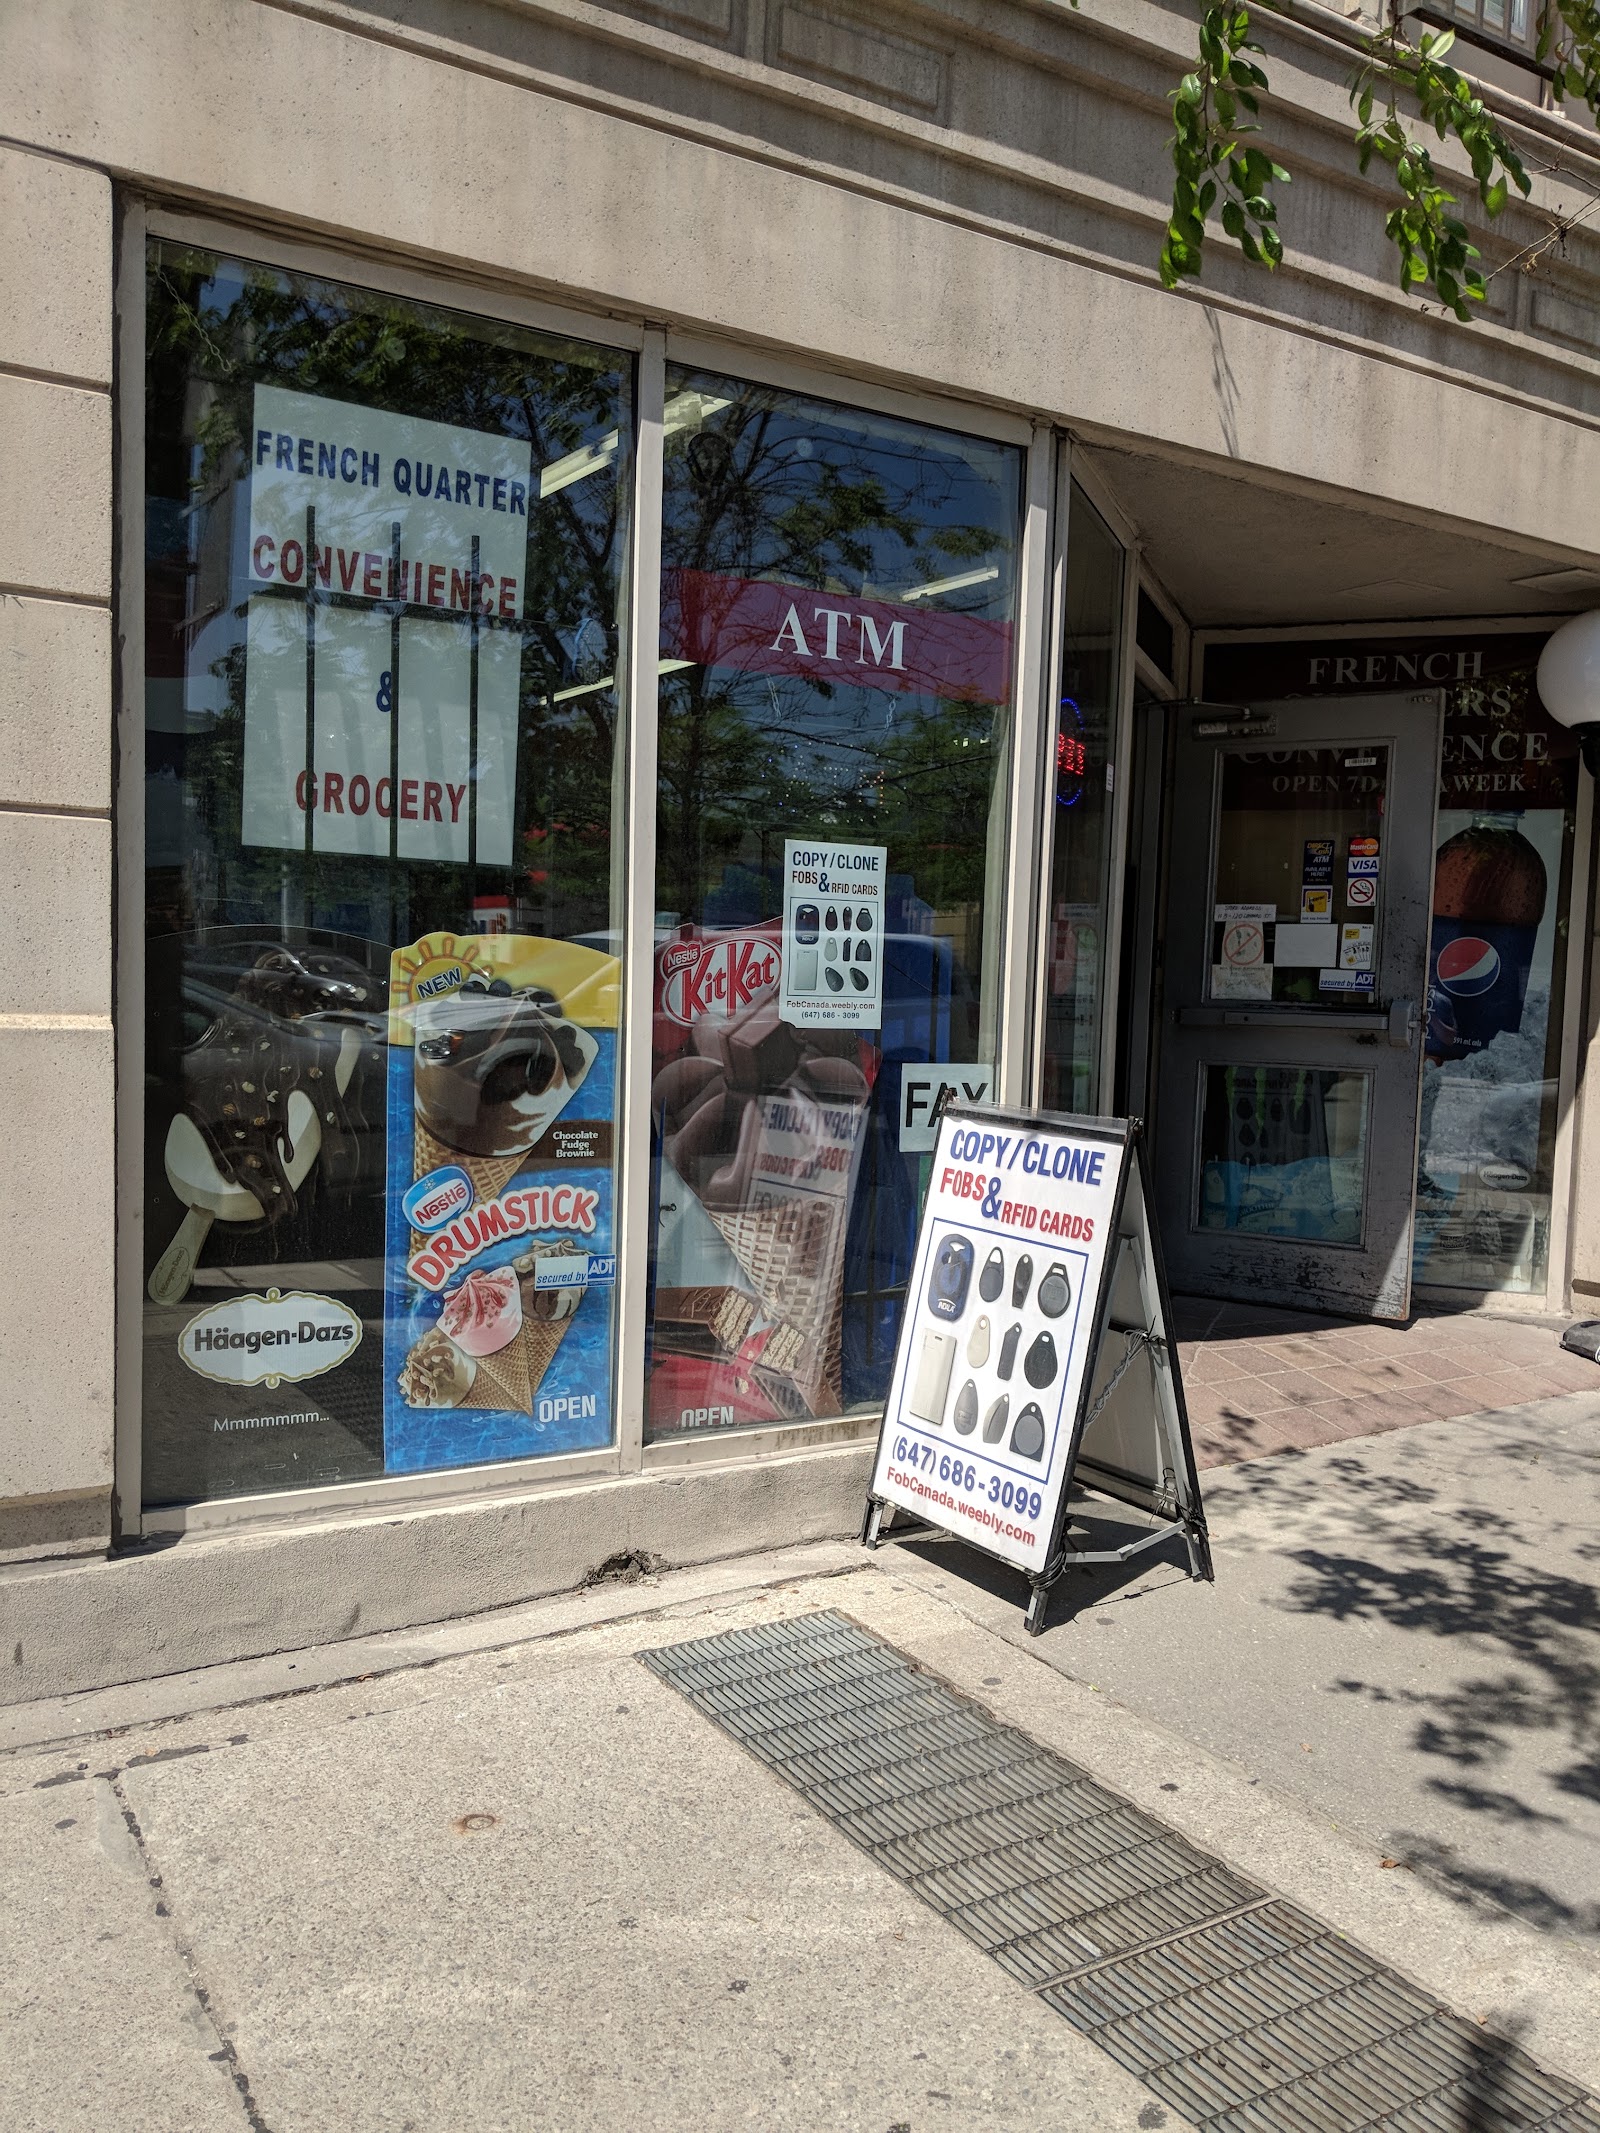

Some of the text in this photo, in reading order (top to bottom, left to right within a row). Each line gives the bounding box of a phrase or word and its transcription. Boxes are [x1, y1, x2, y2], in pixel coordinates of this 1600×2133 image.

[256, 430, 526, 516] FRENCH QUARTER
[769, 602, 909, 671] ATM
[1308, 651, 1483, 685] FRENCH
[296, 770, 467, 824] GROCERY
[1272, 776, 1340, 793] OPEN
[1453, 773, 1527, 793] WEEK
[1352, 860, 1378, 870] VISA
[792, 870, 878, 896] FOBS & RFID CARDS
[417, 967, 461, 999] NEW
[682, 942, 775, 1020] KitKat
[1355, 973, 1375, 985] ADT
[786, 1000, 875, 1011] FobCanada.weebly.com
[801, 1011, 820, 1020] (647)
[553, 1131, 598, 1140] Chocolate
[562, 1140, 590, 1150] Fudge
[556, 1149, 595, 1158] Brownie
[939, 1167, 1094, 1242] FOBS & RFID CARDS
[412, 1189, 595, 1286] DRUMSTICK
[537, 1258, 615, 1284] secured by ADT
[194, 1321, 354, 1354] Häagen-Dazs
[539, 1394, 596, 1423] OPEN
[892, 1435, 937, 1474] (647)
[887, 1466, 1036, 1547] FobCanada.weebly.com
